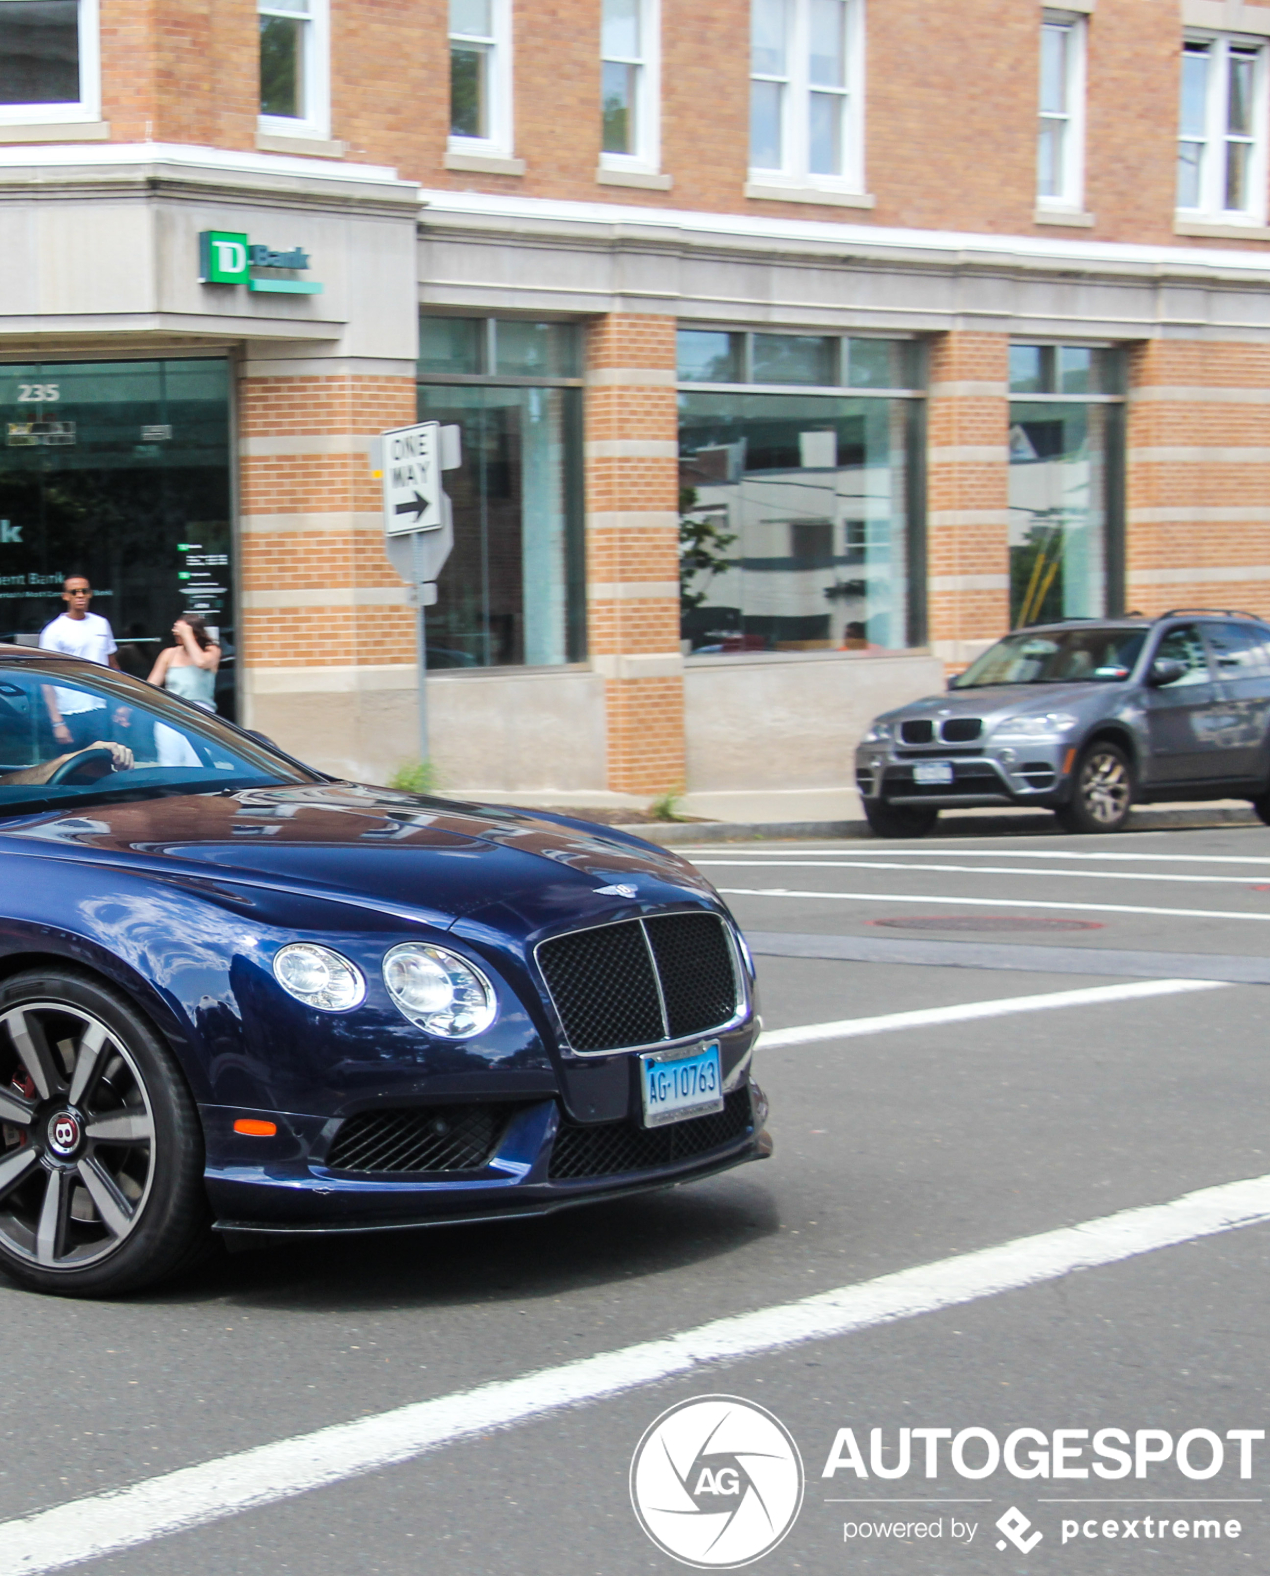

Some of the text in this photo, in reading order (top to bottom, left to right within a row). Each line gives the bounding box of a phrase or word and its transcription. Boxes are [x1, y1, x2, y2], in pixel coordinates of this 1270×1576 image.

[212, 240, 311, 273] TD Bank
[17, 383, 60, 402] 235
[391, 433, 428, 461] ONE
[391, 461, 430, 489] WAY
[28, 570, 66, 585] Bank
